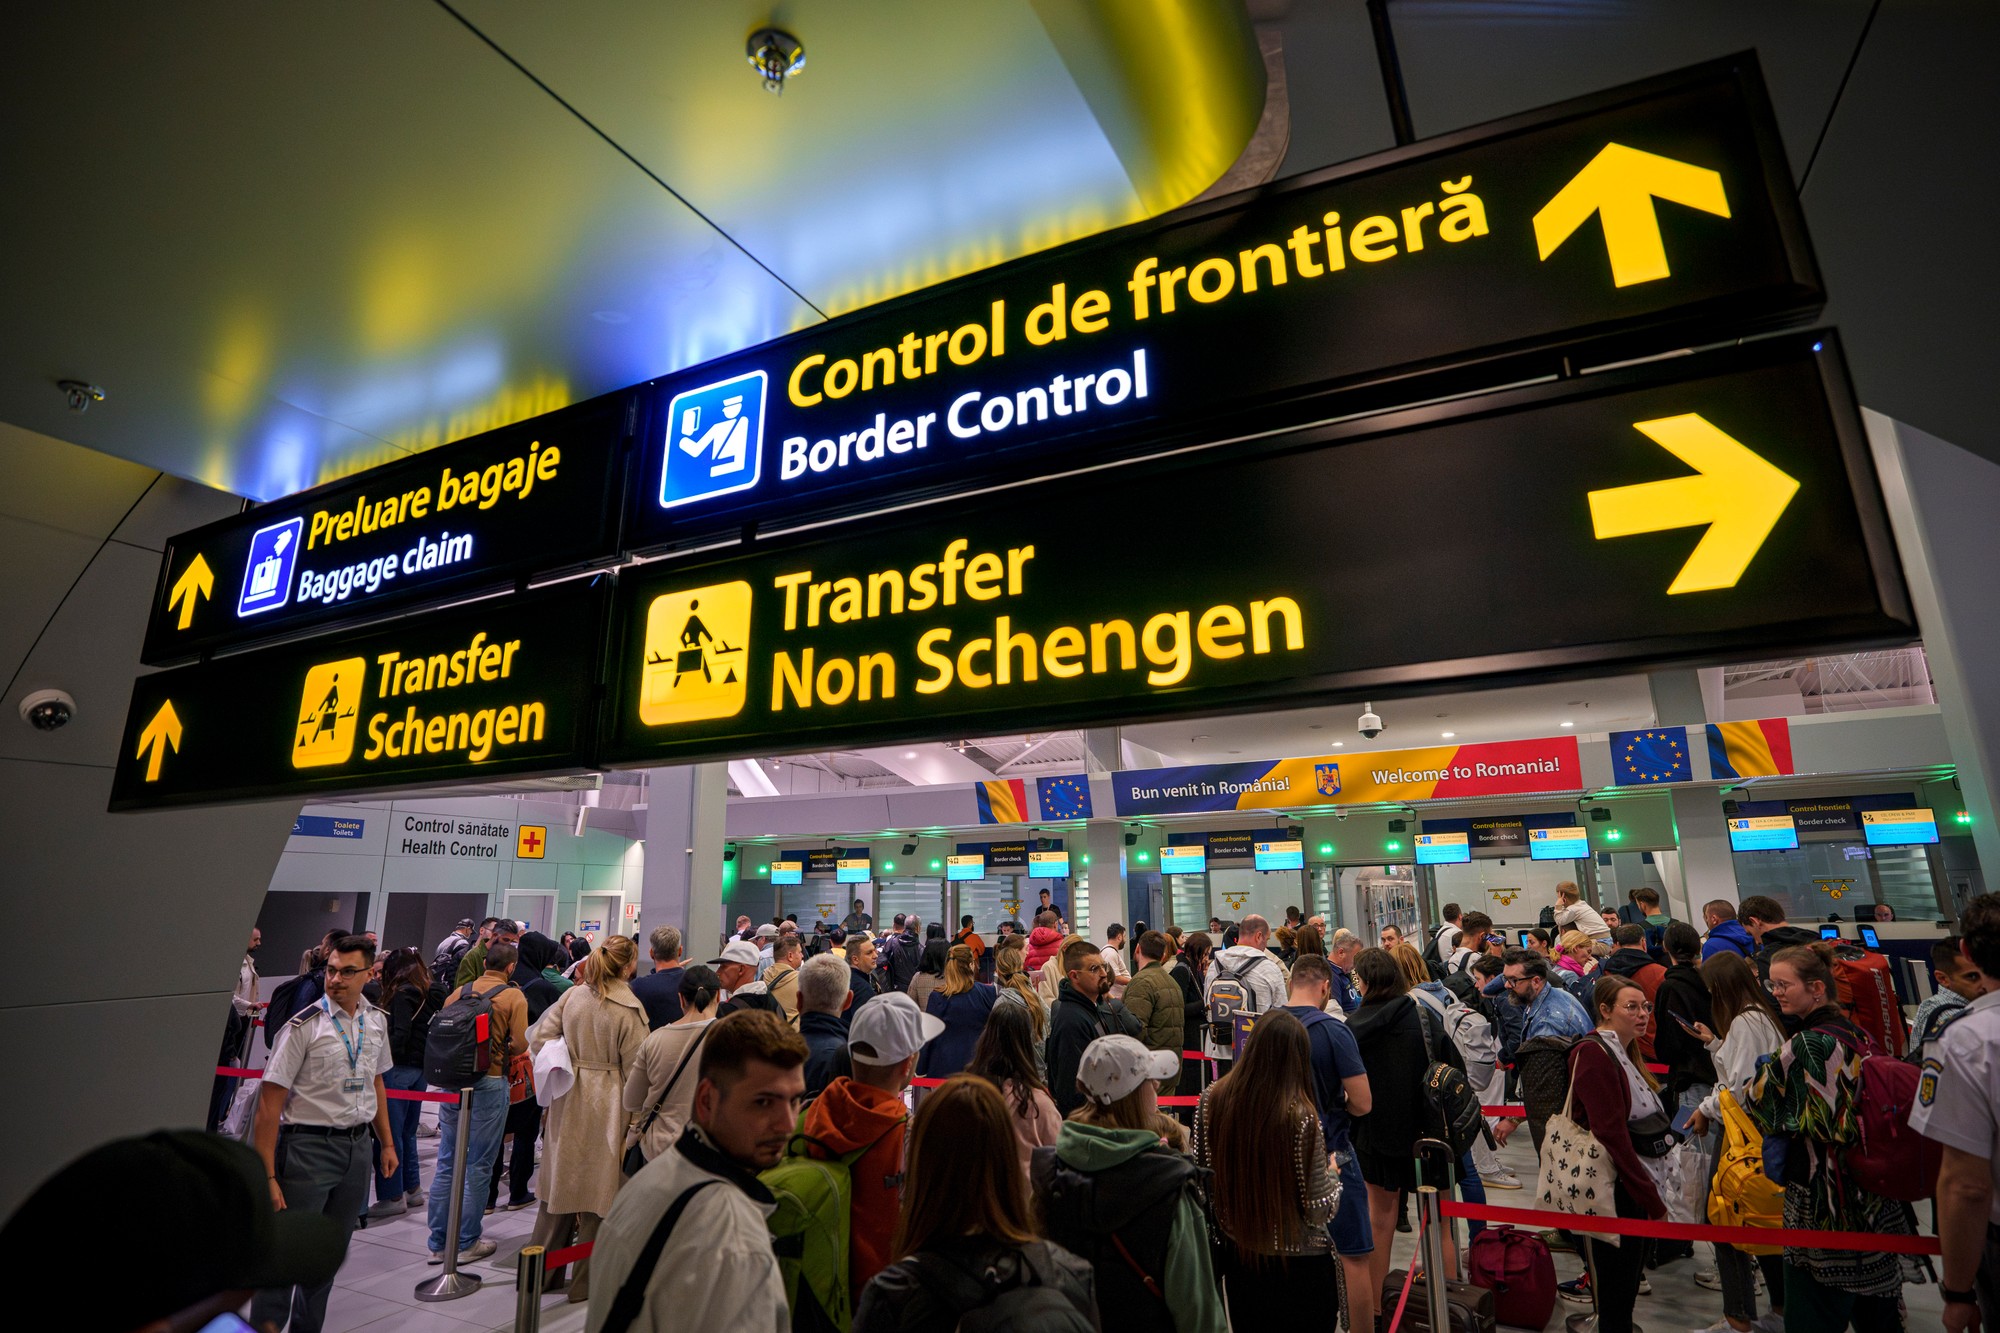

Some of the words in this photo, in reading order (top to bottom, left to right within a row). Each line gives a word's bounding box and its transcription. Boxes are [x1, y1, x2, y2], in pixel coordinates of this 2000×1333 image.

[787, 299, 1005, 408] Control
[1024, 282, 1111, 346] de
[1127, 174, 1490, 321] frontieră
[780, 412, 937, 481] Border
[947, 348, 1148, 439] Control
[307, 495, 431, 551] Preluare
[436, 440, 561, 512] bagaje
[297, 554, 398, 604] Baggage
[402, 531, 473, 575] claim
[774, 538, 1035, 631] Transfer
[376, 631, 521, 698] Transfer
[771, 647, 896, 712] Non
[915, 596, 1305, 695] Schengen
[363, 701, 546, 762] Schengen
[1131, 786, 1160, 800] Bun
[1162, 783, 1199, 798] venit
[1201, 782, 1216, 796] în
[1218, 776, 1291, 795] România!
[1371, 768, 1450, 785] Welcome
[1453, 765, 1472, 779] to
[1475, 757, 1560, 778] Romania!
[334, 821, 360, 829] Toalete
[404, 816, 455, 834] Control
[457, 821, 509, 838] sănătate
[1472, 822, 1495, 830] Control
[1789, 804, 1817, 813] Control
[1798, 818, 1823, 826] Border
[1824, 816, 1847, 824] check
[401, 838, 446, 855] Health
[450, 841, 498, 858] Control
